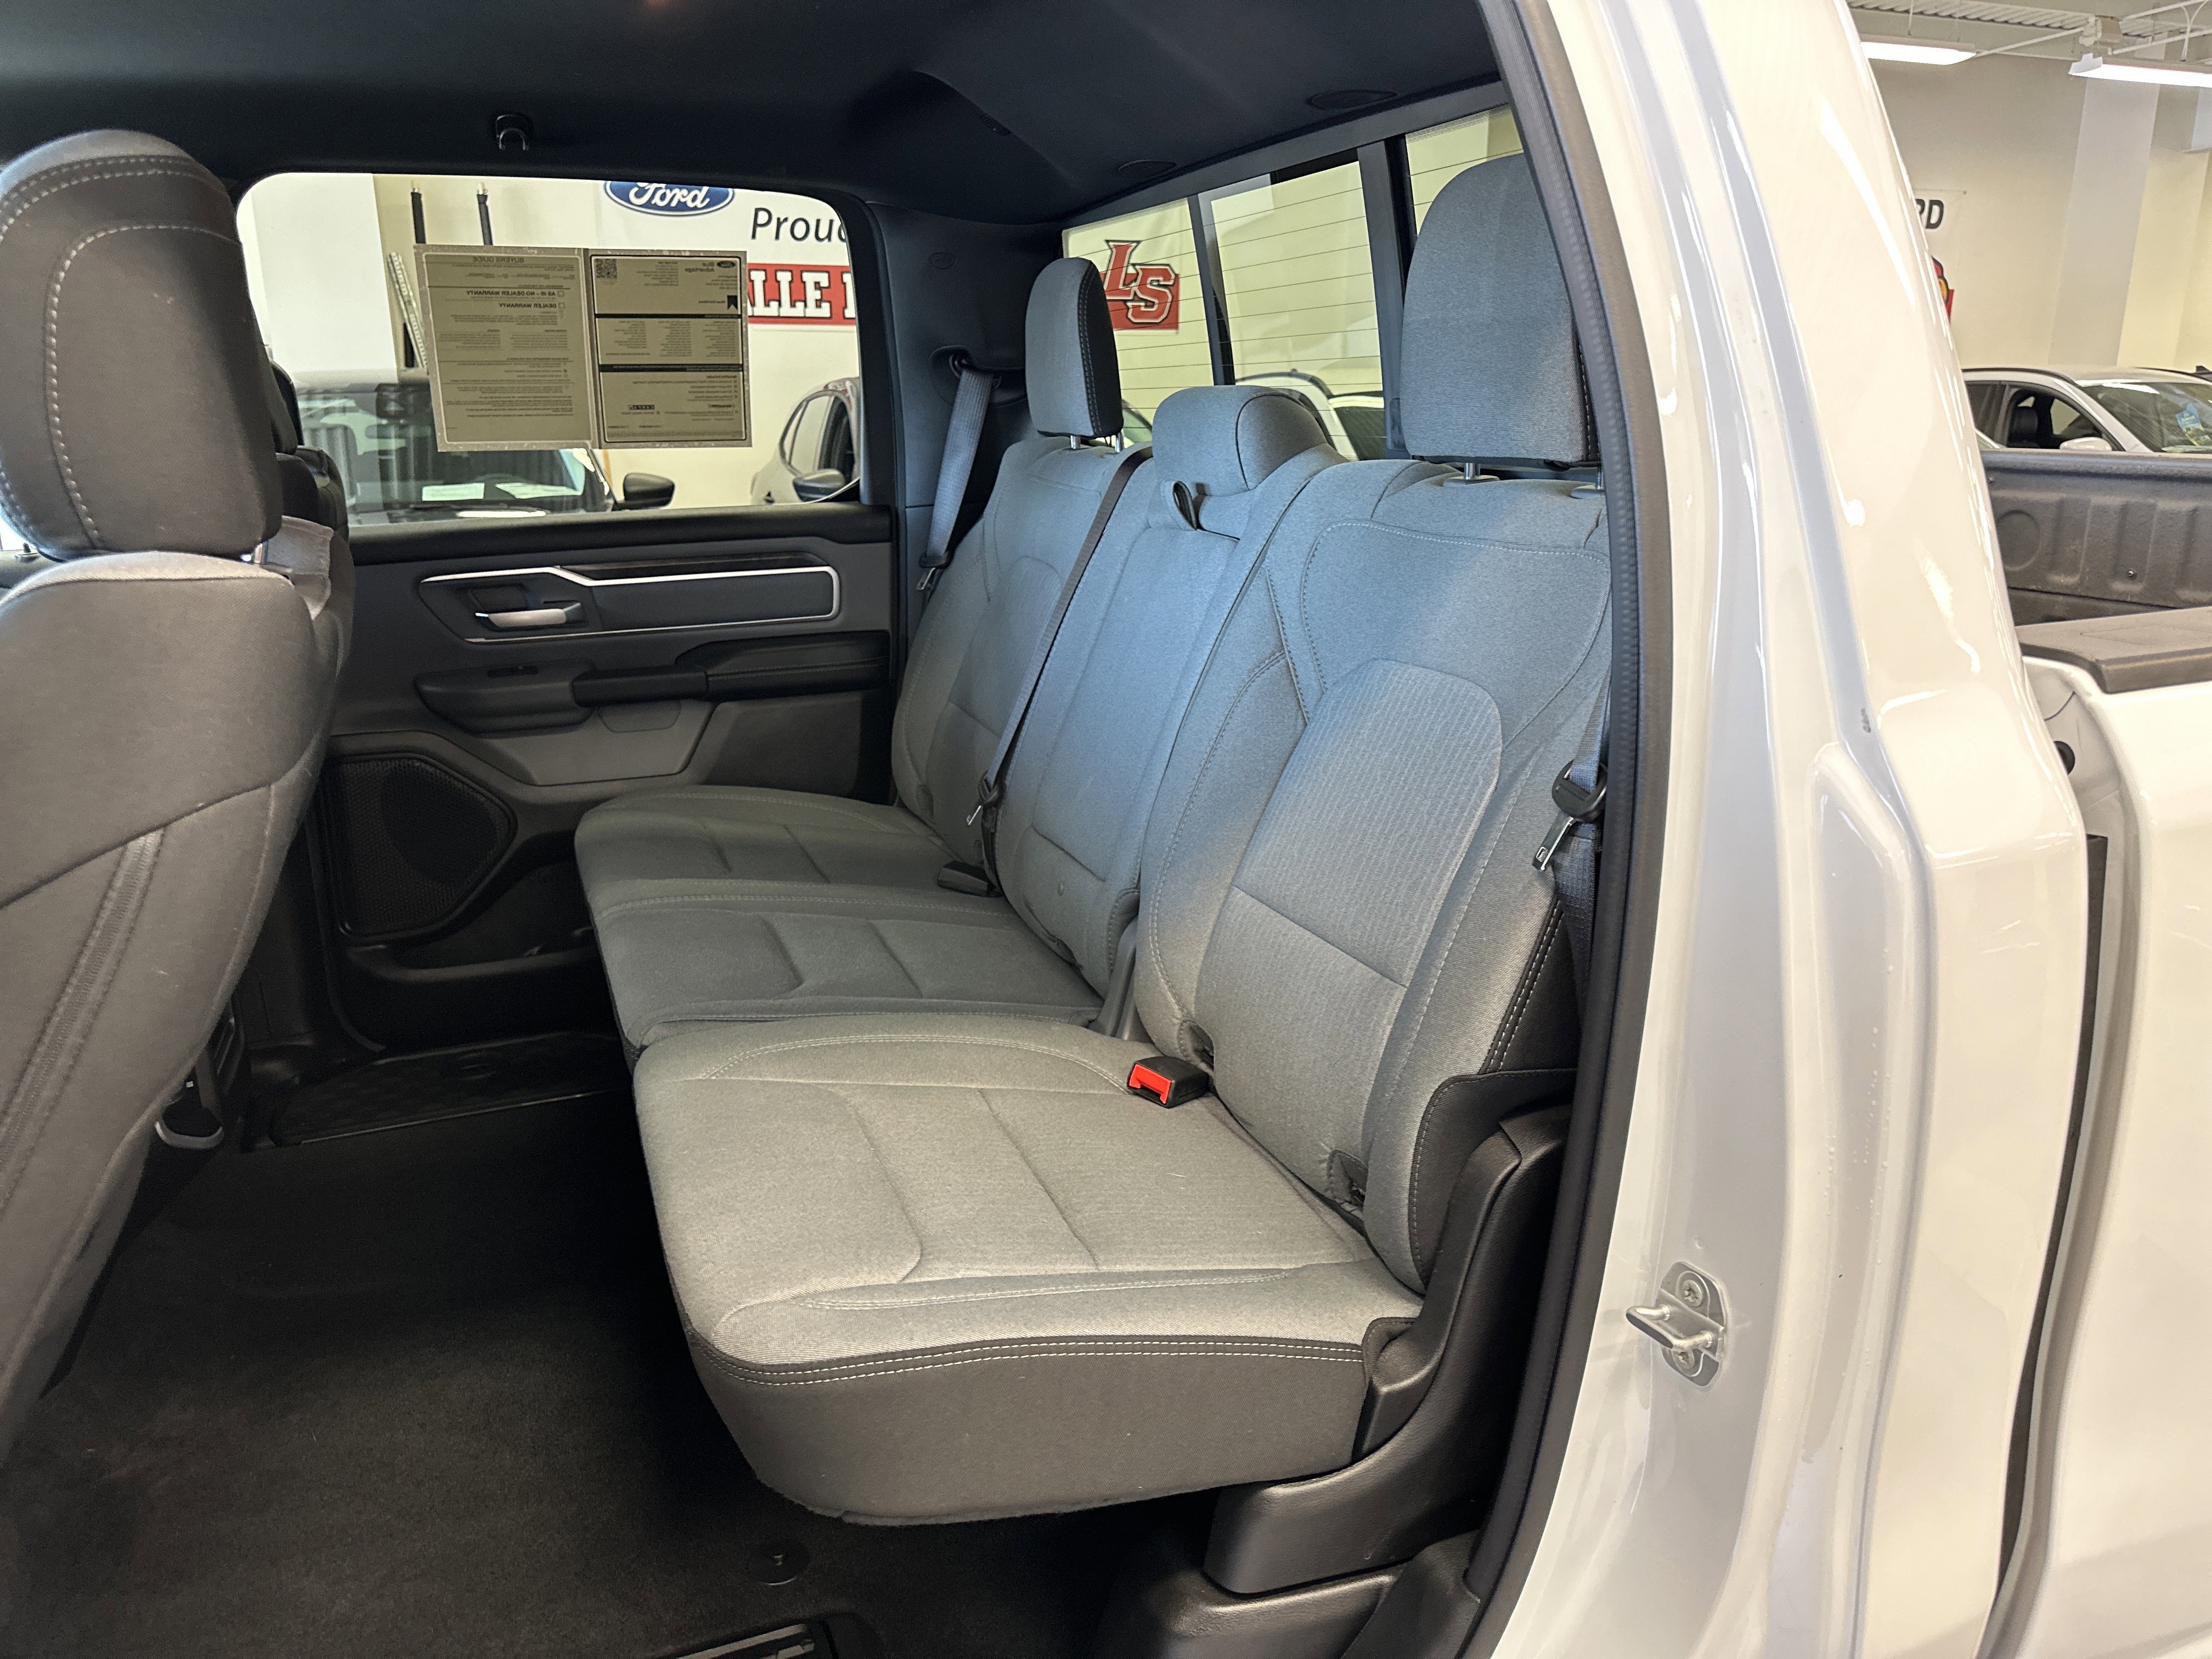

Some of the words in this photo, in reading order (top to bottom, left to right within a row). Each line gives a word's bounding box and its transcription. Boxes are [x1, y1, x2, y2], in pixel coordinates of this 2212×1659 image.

[629, 182, 710, 208] Ford
[748, 269, 833, 319] LLE
[1104, 240, 1176, 325] LS
